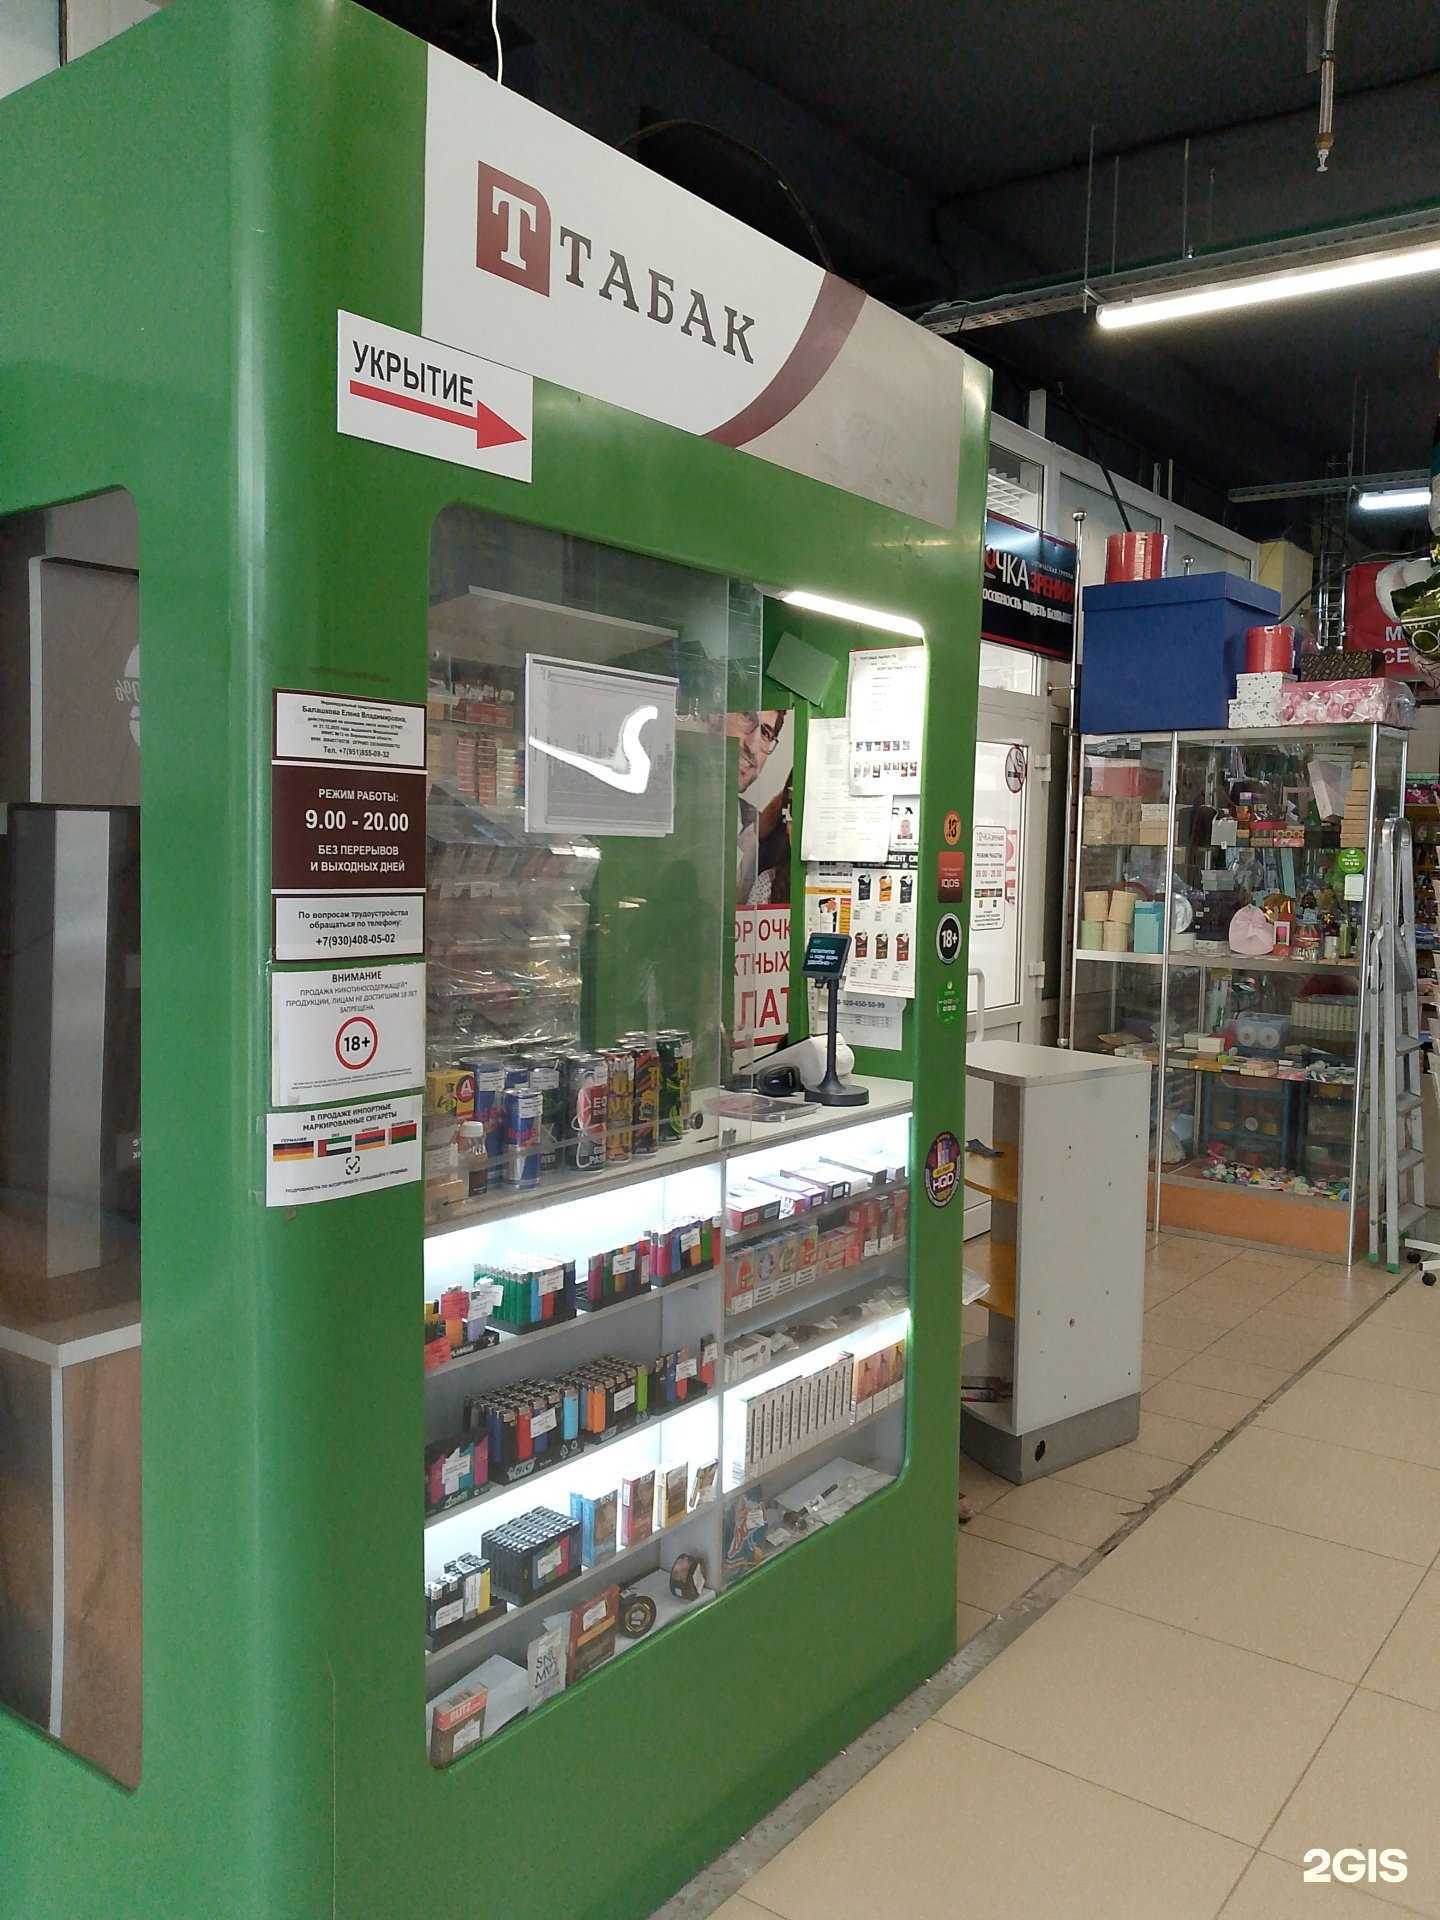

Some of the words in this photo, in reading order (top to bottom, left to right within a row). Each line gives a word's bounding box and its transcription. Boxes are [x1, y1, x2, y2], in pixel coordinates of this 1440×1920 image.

[559, 225, 757, 365] ТАБАК
[352, 340, 474, 408] УКРЫТИЕ
[318, 788, 355, 800] РЕЖИМ
[357, 790, 399, 802] РАБОТЫ:
[305, 809, 346, 829] 9.00
[363, 811, 409, 831] 20.00
[318, 844, 338, 855] БЕЗ
[340, 845, 399, 856] ПЕРЕРЫВОВ
[310, 861, 318, 872] И
[321, 861, 378, 873] ВЫХОДНЫХ
[380, 860, 405, 873] ДНЕЙ
[942, 878, 960, 889] IQOS
[298, 911, 310, 919] По
[312, 911, 349, 920] вопросам
[351, 909, 408, 919] трудоустройства
[309, 920, 355, 930] обращаться
[316, 933, 396, 948] +7(930)408-05-02
[942, 929, 958, 948] 18+
[332, 971, 382, 983] ВНИМАНИЕ
[300, 986, 333, 997] ПРОДАЖА
[344, 1036, 371, 1052] 18+
[310, 1114, 316, 1122] В
[317, 1110, 351, 1121] ПРОДАЖЕ
[352, 1103, 392, 1116] ИМПОРТНЫЕ
[302, 1116, 364, 1131] МАРКИРОВАННЫЕ
[366, 1112, 397, 1123] СИГАРЕТЫ
